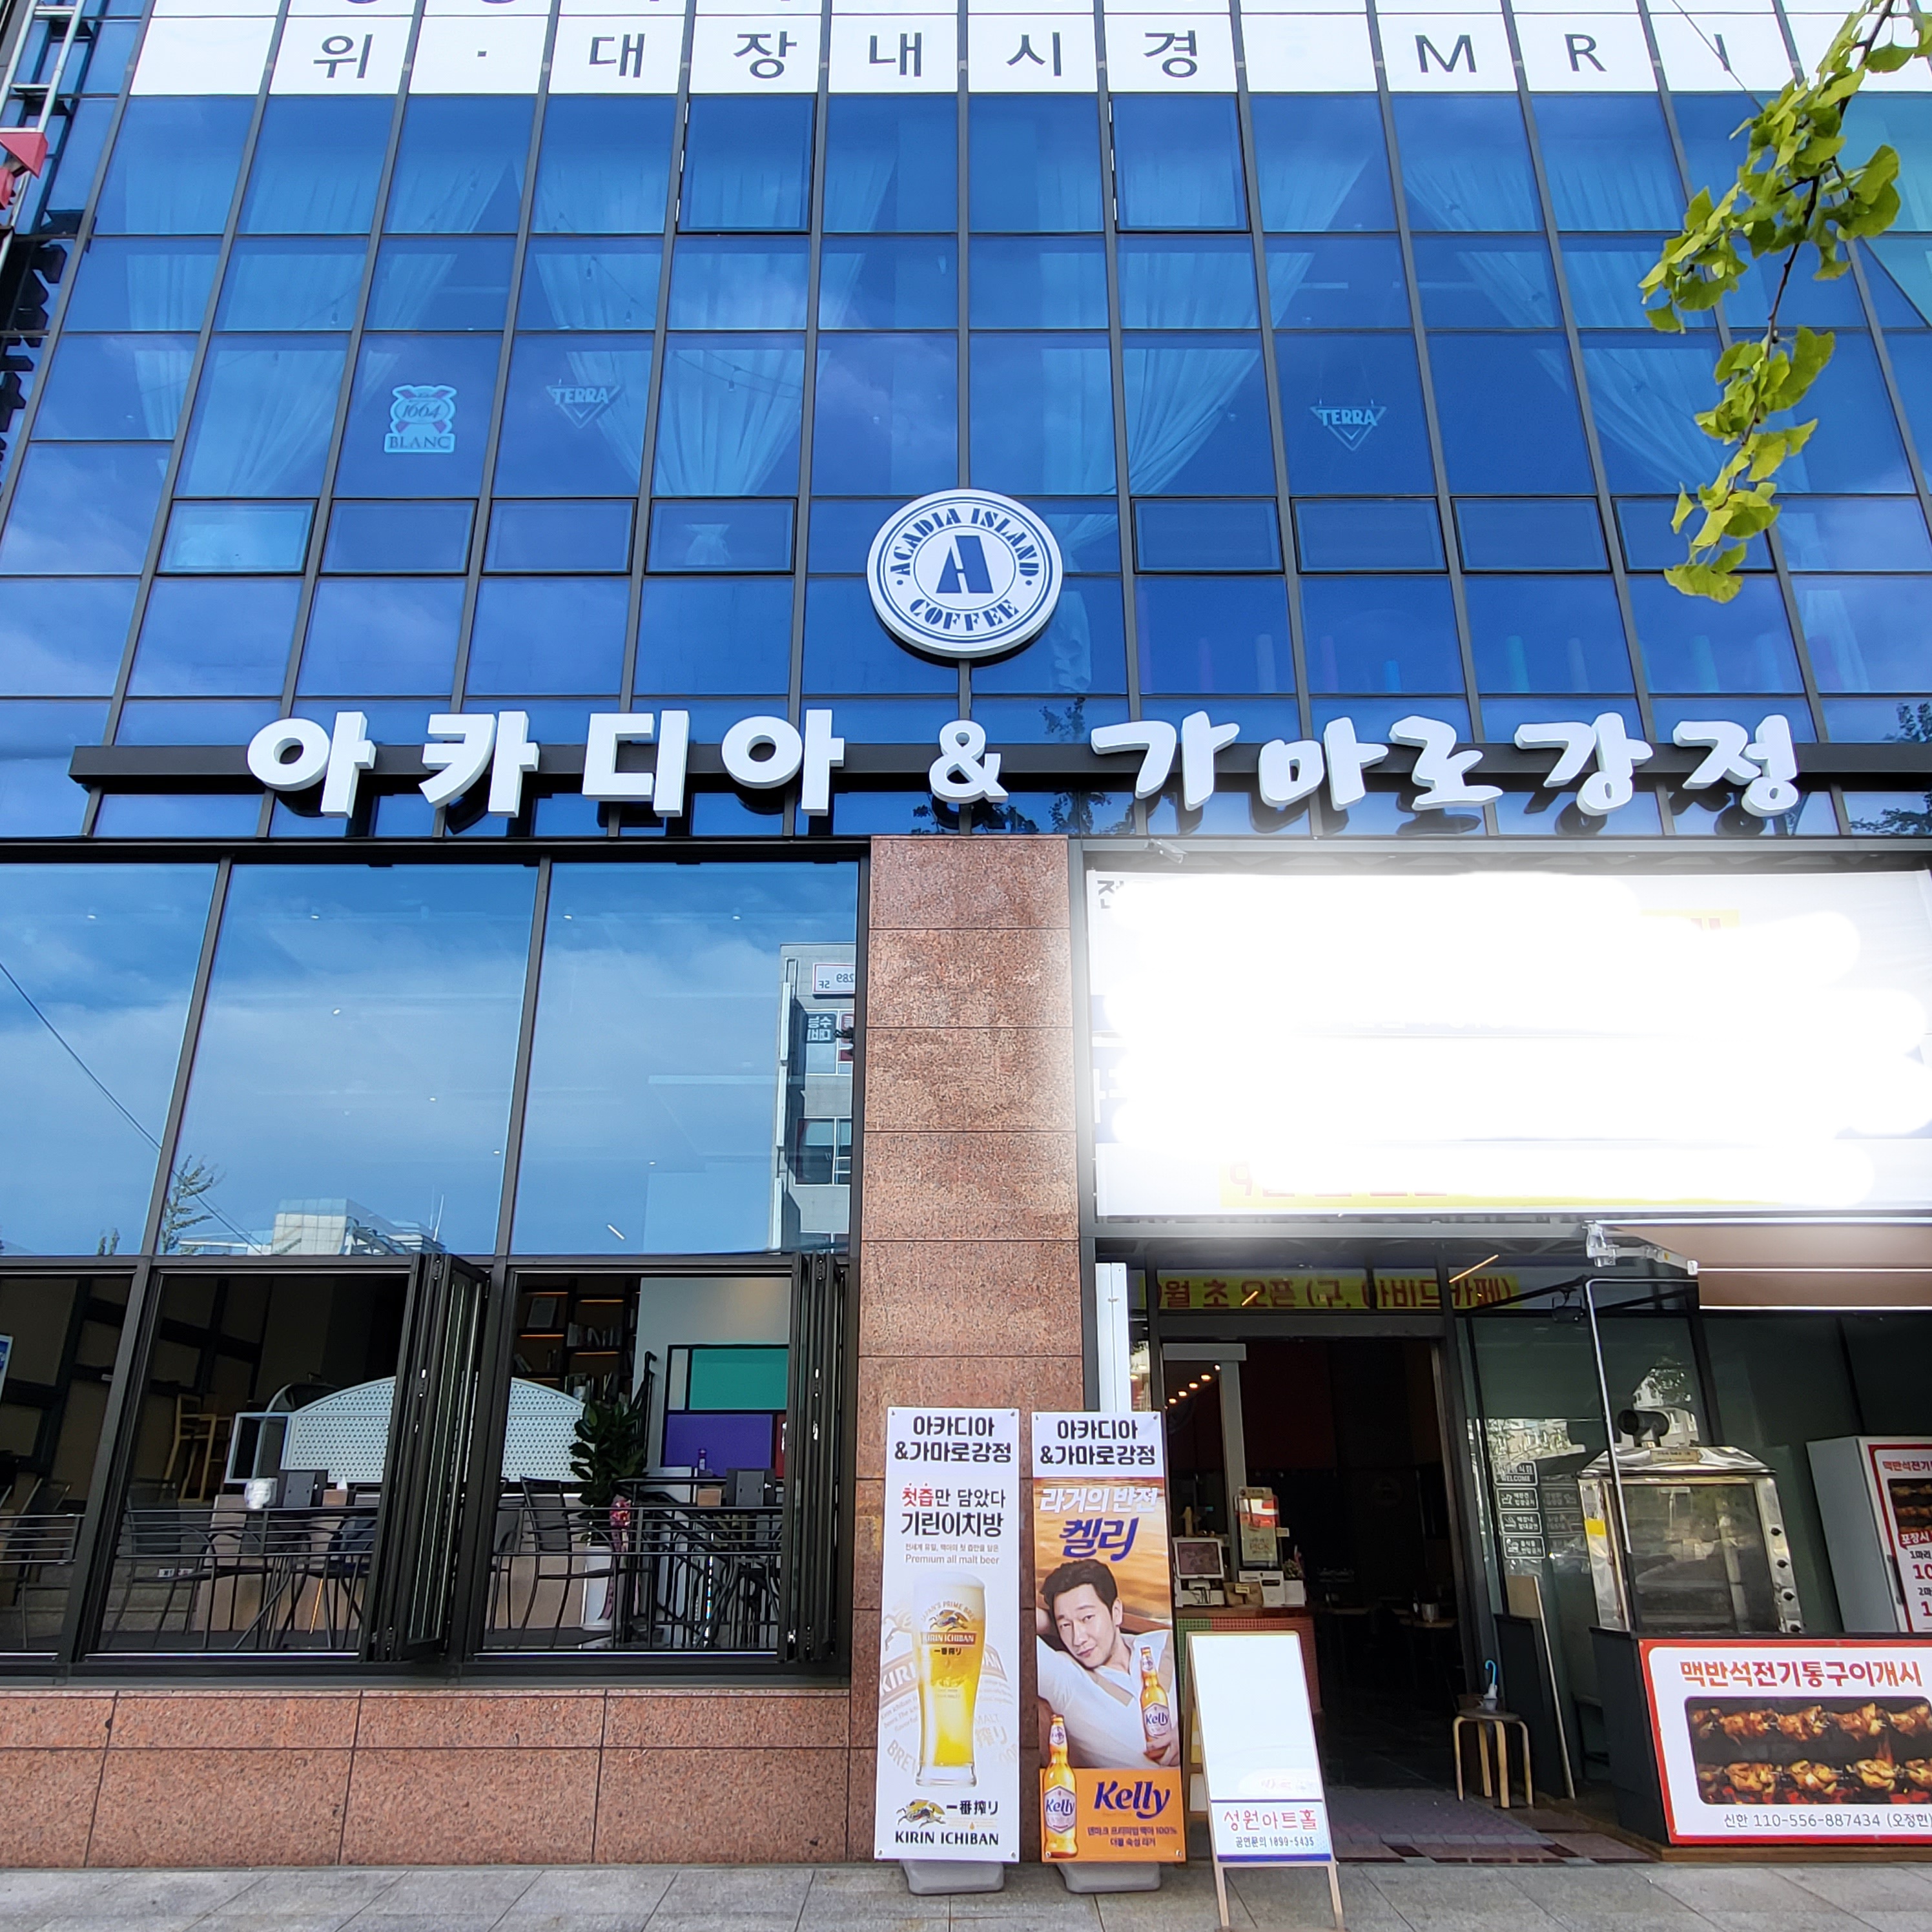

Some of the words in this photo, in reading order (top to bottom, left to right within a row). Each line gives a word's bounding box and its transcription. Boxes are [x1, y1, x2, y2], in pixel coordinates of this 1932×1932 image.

[1414, 33, 1732, 74] MRI
[552, 387, 610, 406] TERRA
[402, 402, 442, 418] 1664
[1317, 408, 1377, 426] TERRA
[389, 436, 451, 449] BLANC
[890, 508, 962, 577] ACADIA
[971, 507, 1040, 577] ISLAND
[909, 599, 1020, 632] COFFEE
[246, 708, 845, 818] 아카디아
[927, 718, 1010, 805] &
[1090, 710, 1801, 817] 가마로강정
[1158, 1280, 1191, 1308] 월
[1203, 1279, 1229, 1308] 초
[1240, 1279, 1296, 1308] 오픈
[912, 1415, 995, 1437] 아카디아
[1057, 1419, 1138, 1440] 아카디아
[894, 1441, 1012, 1463] &가마로강정
[1040, 1444, 1156, 1466] &가마로강정
[1882, 1461, 1932, 1472] 맥반석전기
[901, 1486, 951, 1508] 첫즙만
[958, 1488, 1006, 1508] 담았다
[1040, 1488, 1109, 1514] 라거의
[1112, 1486, 1158, 1514] 반전
[901, 1511, 1004, 1537] 기린이치방
[1059, 1516, 1140, 1562] 켈리
[1901, 1531, 1930, 1545] 포장시
[905, 1554, 945, 1564] Premium
[947, 1554, 957, 1564] all
[959, 1555, 978, 1565] malt
[980, 1555, 1000, 1565] beer
[942, 1601, 962, 1610] PRIME
[879, 1661, 917, 1697] KIRI
[1680, 1661, 1923, 1687] 맥반석전기통구이개시
[1146, 1712, 1169, 1726] Kelly
[946, 1800, 998, 1816] 一番搾り
[1045, 1798, 1074, 1816] Kelly
[1093, 1780, 1171, 1819] Kelly
[1224, 1809, 1317, 1832] 성원아트홀
[1724, 1813, 1749, 1828] 신한
[1753, 1813, 1880, 1828] 110-556-887434
[895, 1830, 935, 1845] KIRIN
[941, 1831, 999, 1846] ICHIBAN
[1235, 1836, 1267, 1848] 공연문의
